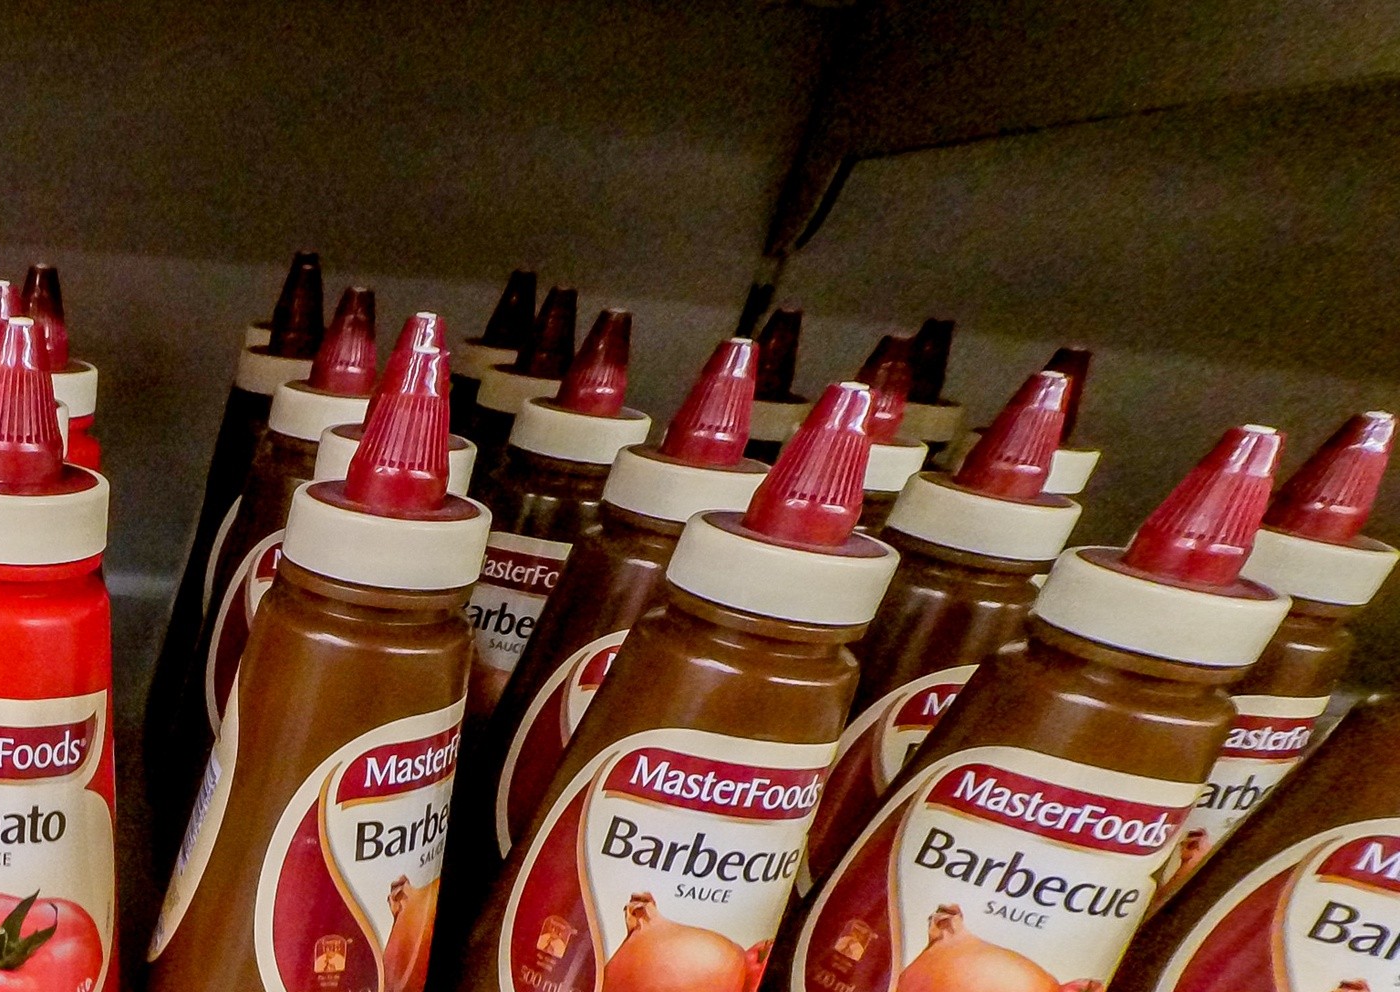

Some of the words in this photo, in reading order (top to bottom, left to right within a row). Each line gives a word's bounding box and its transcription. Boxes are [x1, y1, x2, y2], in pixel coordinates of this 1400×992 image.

[482, 555, 560, 588] asterFo
[629, 754, 822, 811] MasterFoods
[953, 771, 1171, 848] MasterFoods
[600, 814, 800, 883] Barbecue
[914, 827, 1141, 919] Barbecue
[674, 883, 731, 904] SAUCE
[983, 900, 1049, 930] SAUCE
